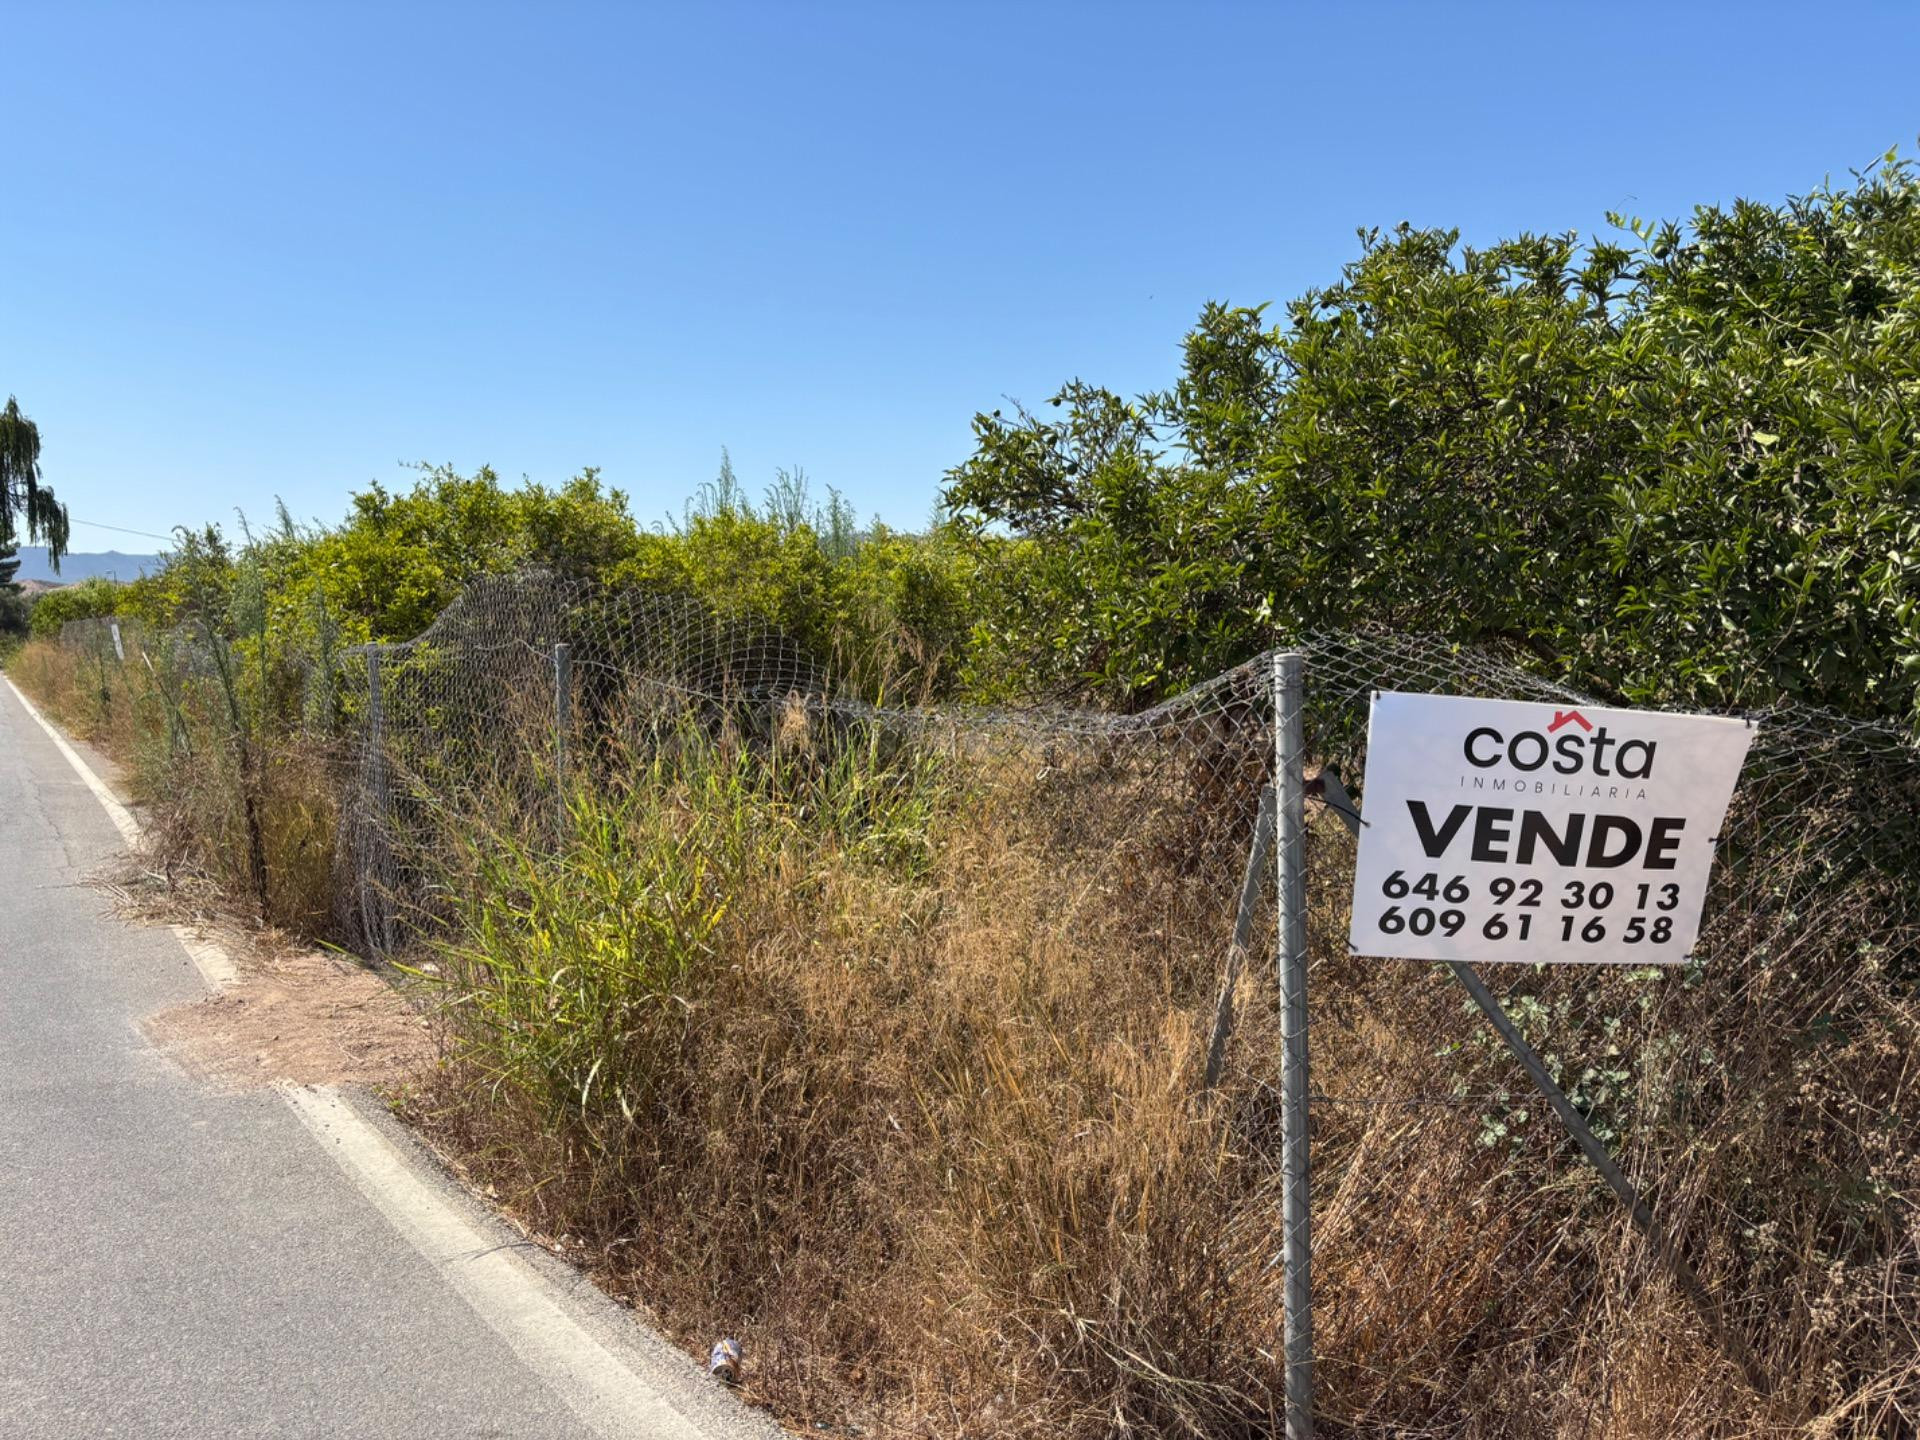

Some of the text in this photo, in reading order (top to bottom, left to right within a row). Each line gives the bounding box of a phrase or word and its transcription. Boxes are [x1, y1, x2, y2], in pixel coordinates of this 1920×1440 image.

[1463, 726, 1657, 779] costa
[1460, 775, 1647, 800] INMOBILIARIA
[1406, 800, 1686, 869] VENDE
[1382, 870, 1680, 911] 646 92 30 13
[1378, 906, 1673, 944] 609 61 16 58
